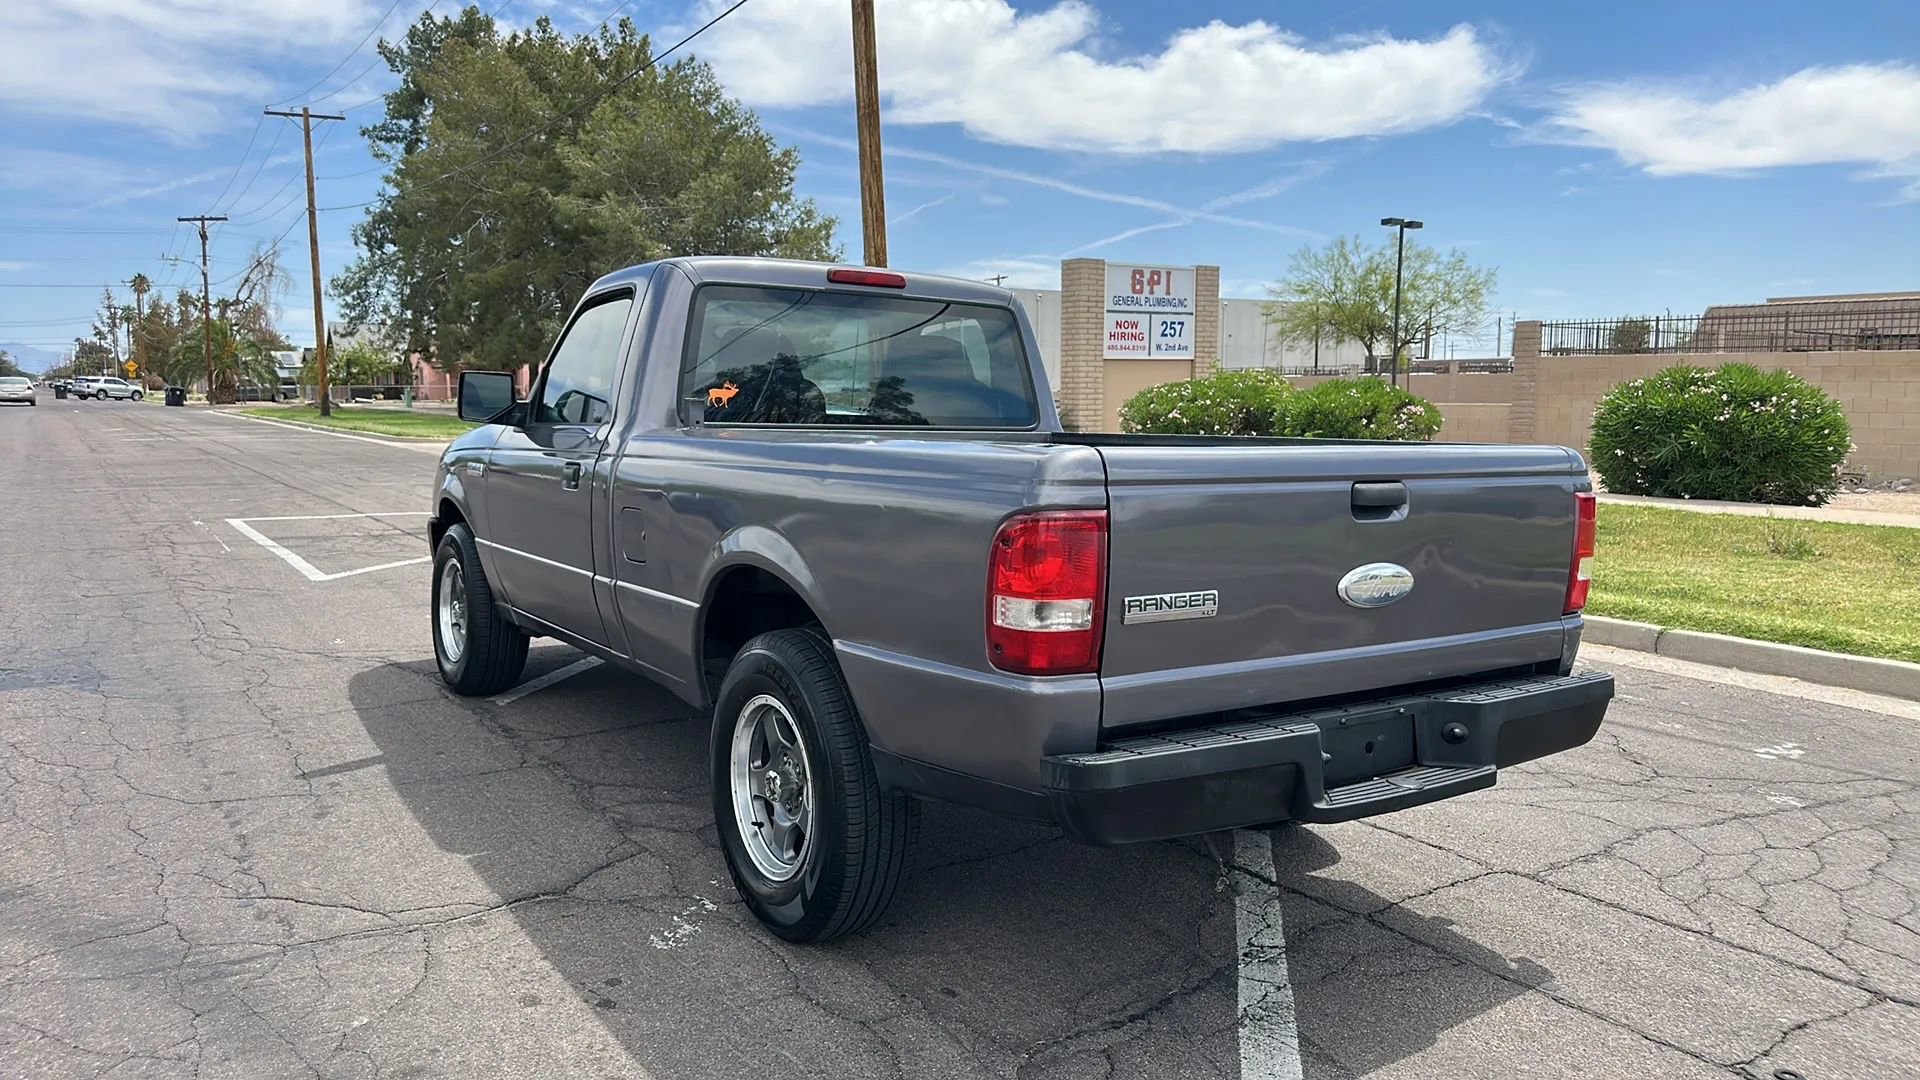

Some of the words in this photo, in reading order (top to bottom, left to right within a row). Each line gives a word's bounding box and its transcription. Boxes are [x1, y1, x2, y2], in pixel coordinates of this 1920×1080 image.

[1131, 269, 1171, 296] GPI
[1112, 296, 1143, 307] GENERAL
[1115, 320, 1139, 330] NOW
[1160, 321, 1185, 338] 257
[1109, 331, 1145, 342] HIRING
[1177, 344, 1189, 352] Ave
[1127, 592, 1217, 614] RANGER
